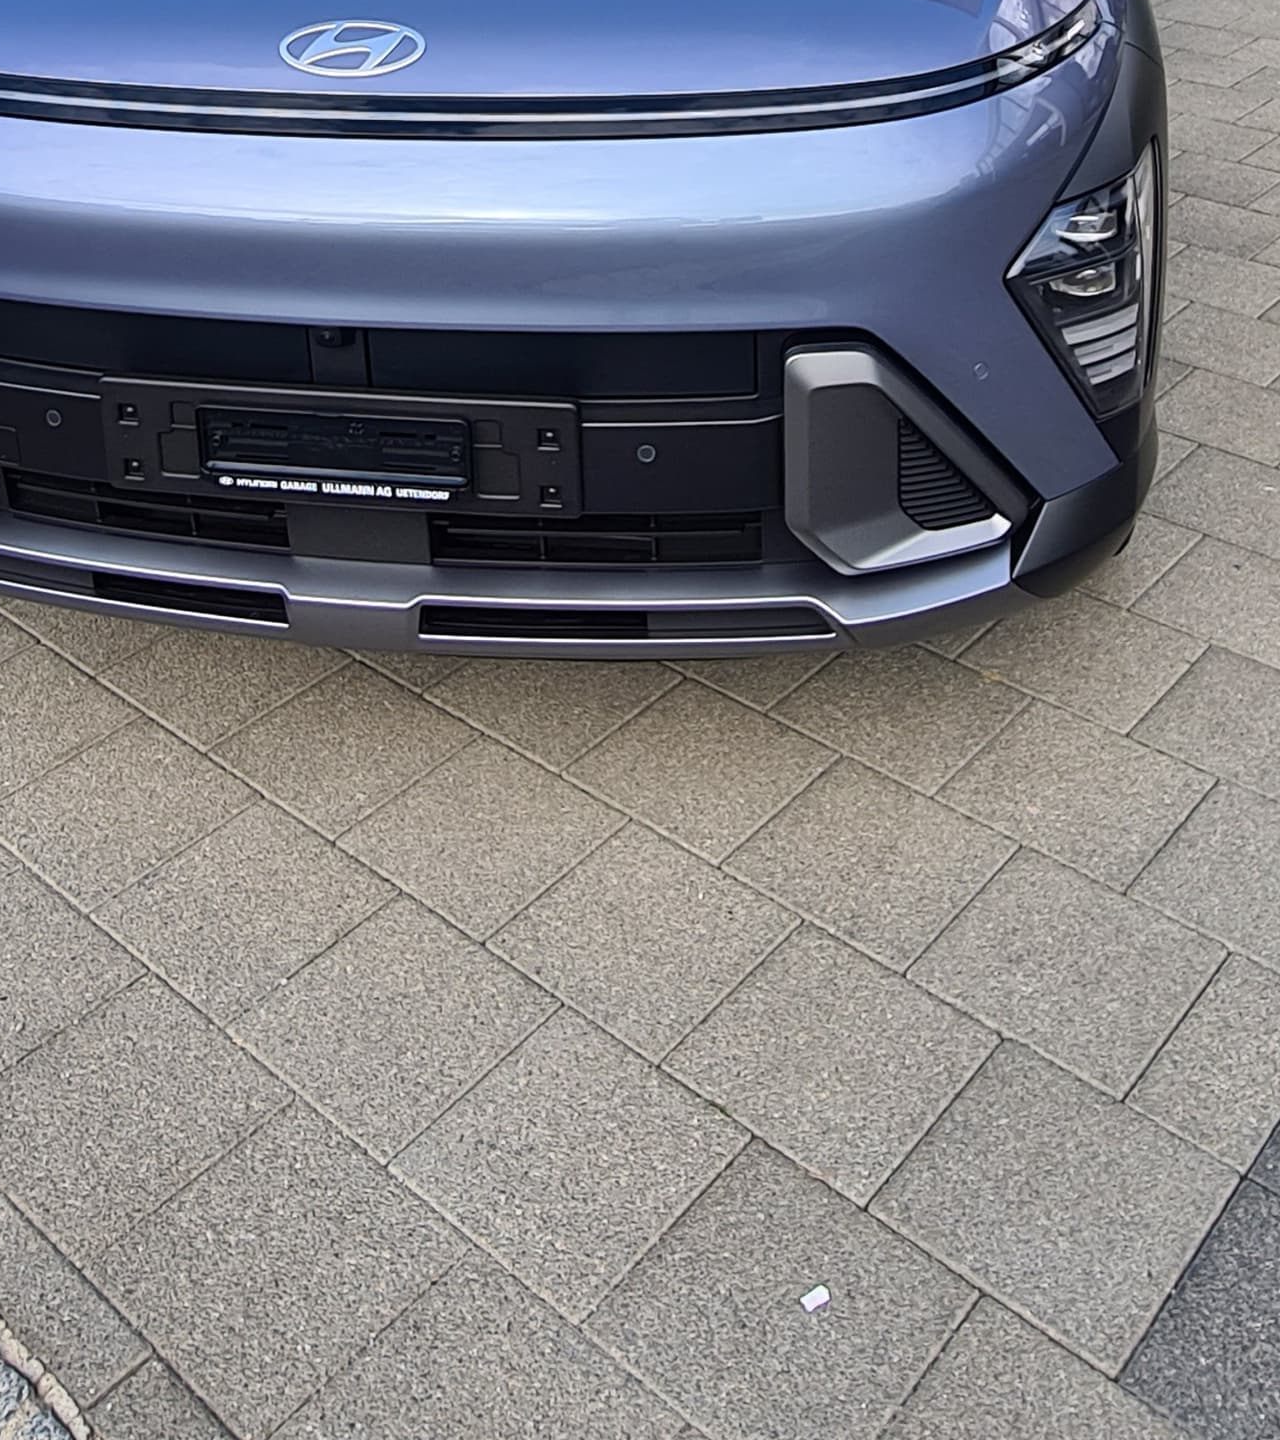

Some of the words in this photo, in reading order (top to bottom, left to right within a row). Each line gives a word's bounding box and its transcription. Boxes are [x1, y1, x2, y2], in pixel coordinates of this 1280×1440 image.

[280, 480, 318, 492] GARAGE
[322, 482, 375, 496] ULLMANN
[376, 486, 392, 498] AG
[395, 488, 450, 500] UETENDORF
